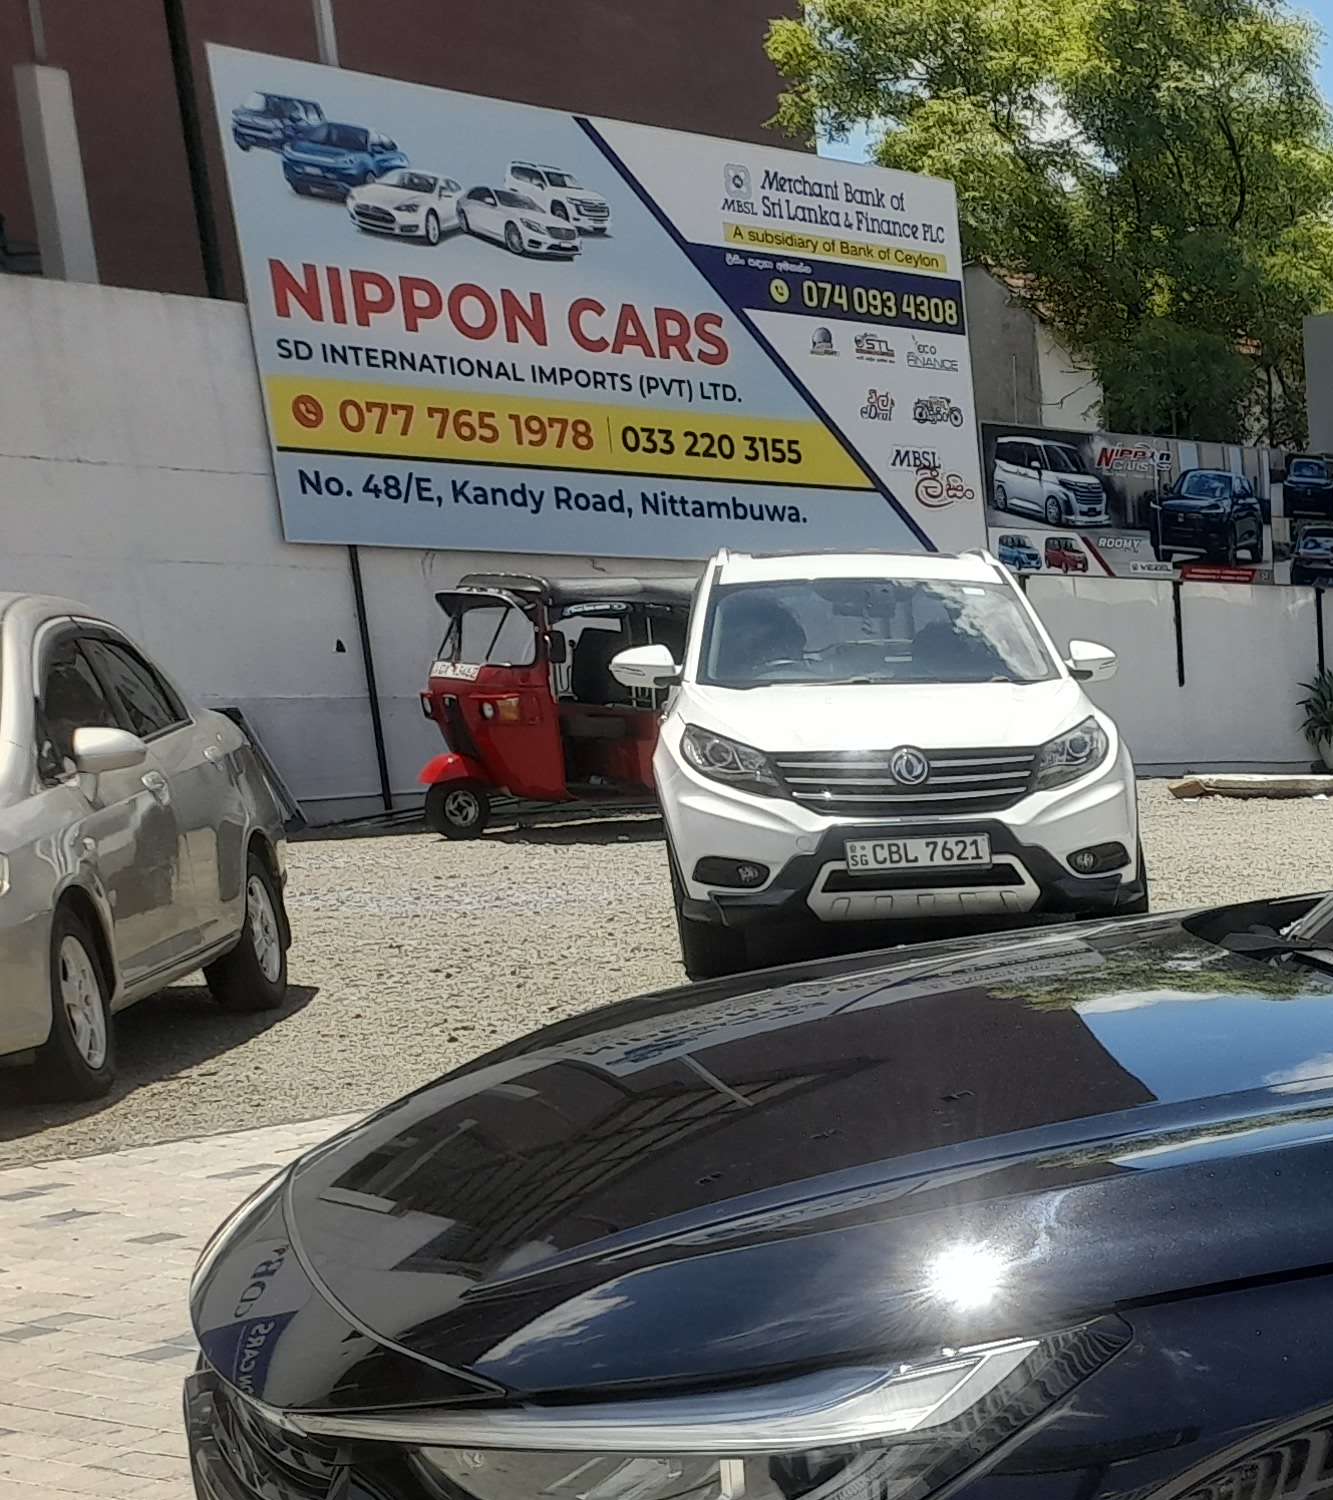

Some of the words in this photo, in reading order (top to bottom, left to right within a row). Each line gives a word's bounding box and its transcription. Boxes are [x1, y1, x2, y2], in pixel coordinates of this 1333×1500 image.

[721, 198, 758, 216] MBSL
[761, 170, 839, 201] Merchant
[844, 182, 885, 208] Bank
[890, 192, 906, 211] of
[762, 196, 784, 219] Sri
[785, 200, 840, 228] Lanka
[844, 212, 853, 229] &
[856, 211, 918, 239] Finance
[922, 223, 945, 244] PLC
[733, 226, 743, 240] A
[748, 229, 818, 253] subsidiary
[823, 238, 836, 253] of
[840, 242, 874, 258] Bank
[878, 247, 892, 261] of
[894, 249, 939, 269] Ceylon
[267, 258, 548, 347] NIPPON
[567, 298, 729, 365] CARS
[802, 280, 849, 312] 074
[853, 287, 897, 318] 093
[902, 293, 958, 326] 4308
[276, 339, 313, 361] SD
[321, 344, 525, 382] INTERNATIONAL
[531, 365, 632, 393] IMPORTS
[639, 374, 693, 402] (PVT)
[700, 382, 742, 403] LTD.
[907, 352, 959, 372] FINANCE
[339, 399, 414, 436] 077
[427, 406, 499, 443] 765
[508, 413, 594, 451] 1978
[621, 426, 675, 454] 033
[684, 431, 735, 460] 220
[744, 436, 803, 464] 3155
[891, 449, 941, 468] MBSL
[298, 470, 352, 497] No.
[362, 471, 443, 508] 48/E,
[451, 480, 545, 515] Kandy
[554, 486, 634, 519] Road,
[641, 491, 808, 525] Nittambuwa.
[1098, 537, 1142, 549] ROOMY
[851, 854, 869, 867] SG
[872, 842, 919, 865] CBL
[925, 838, 983, 862] 7621
